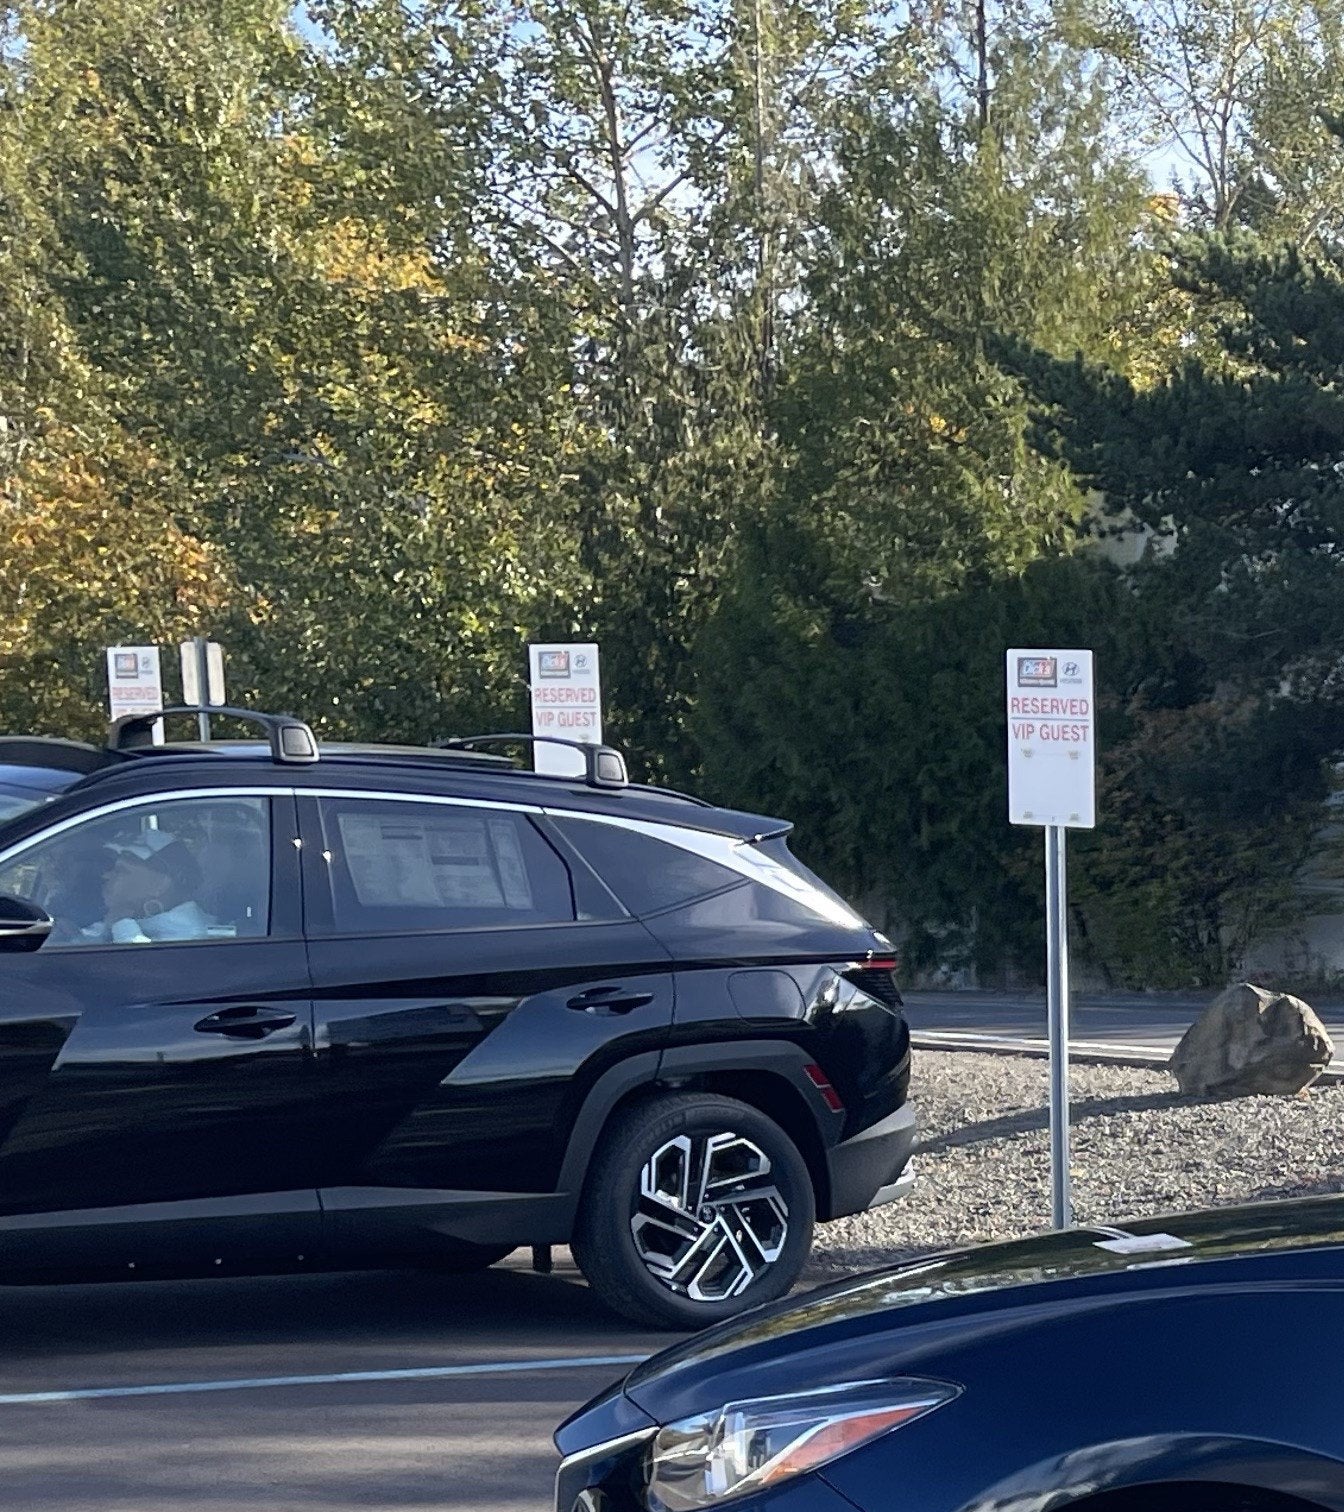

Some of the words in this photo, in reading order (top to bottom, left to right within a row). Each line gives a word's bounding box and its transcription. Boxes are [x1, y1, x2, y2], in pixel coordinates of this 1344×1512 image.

[534, 687, 597, 704] RESERVED
[1010, 697, 1090, 717] RESERVED
[535, 711, 555, 727] VIP
[557, 711, 597, 728] GUEST
[1011, 723, 1035, 741] VIP
[1039, 724, 1090, 742] GUEST
